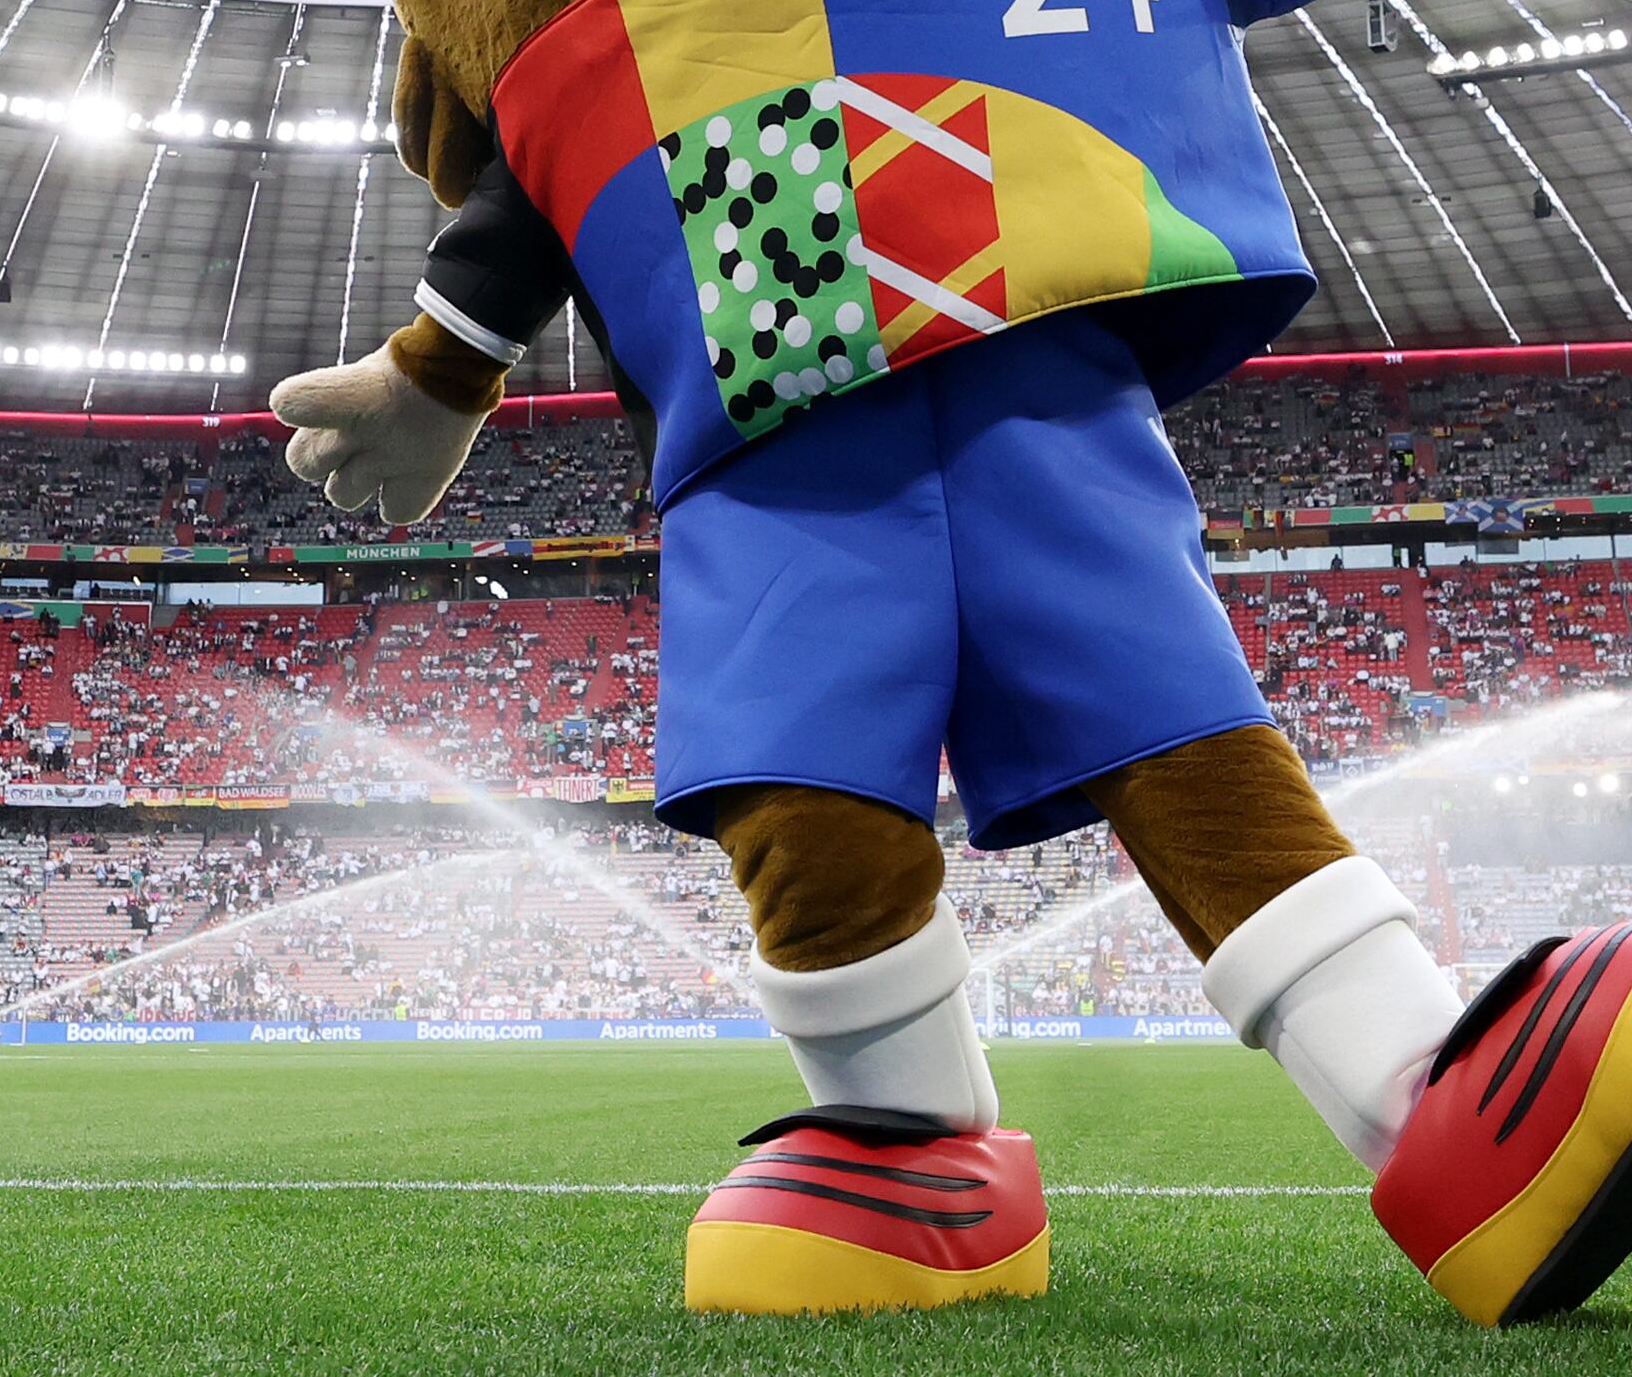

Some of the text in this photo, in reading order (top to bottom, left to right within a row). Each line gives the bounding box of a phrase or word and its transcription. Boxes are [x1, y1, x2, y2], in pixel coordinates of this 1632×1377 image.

[346, 544, 421, 560] MÜNCHEN
[218, 787, 239, 799] BAD
[240, 786, 286, 799] WALDSEE
[66, 1022, 195, 1045] Booking.com
[416, 1021, 543, 1043] Booking.com
[600, 1022, 717, 1041] Apartments
